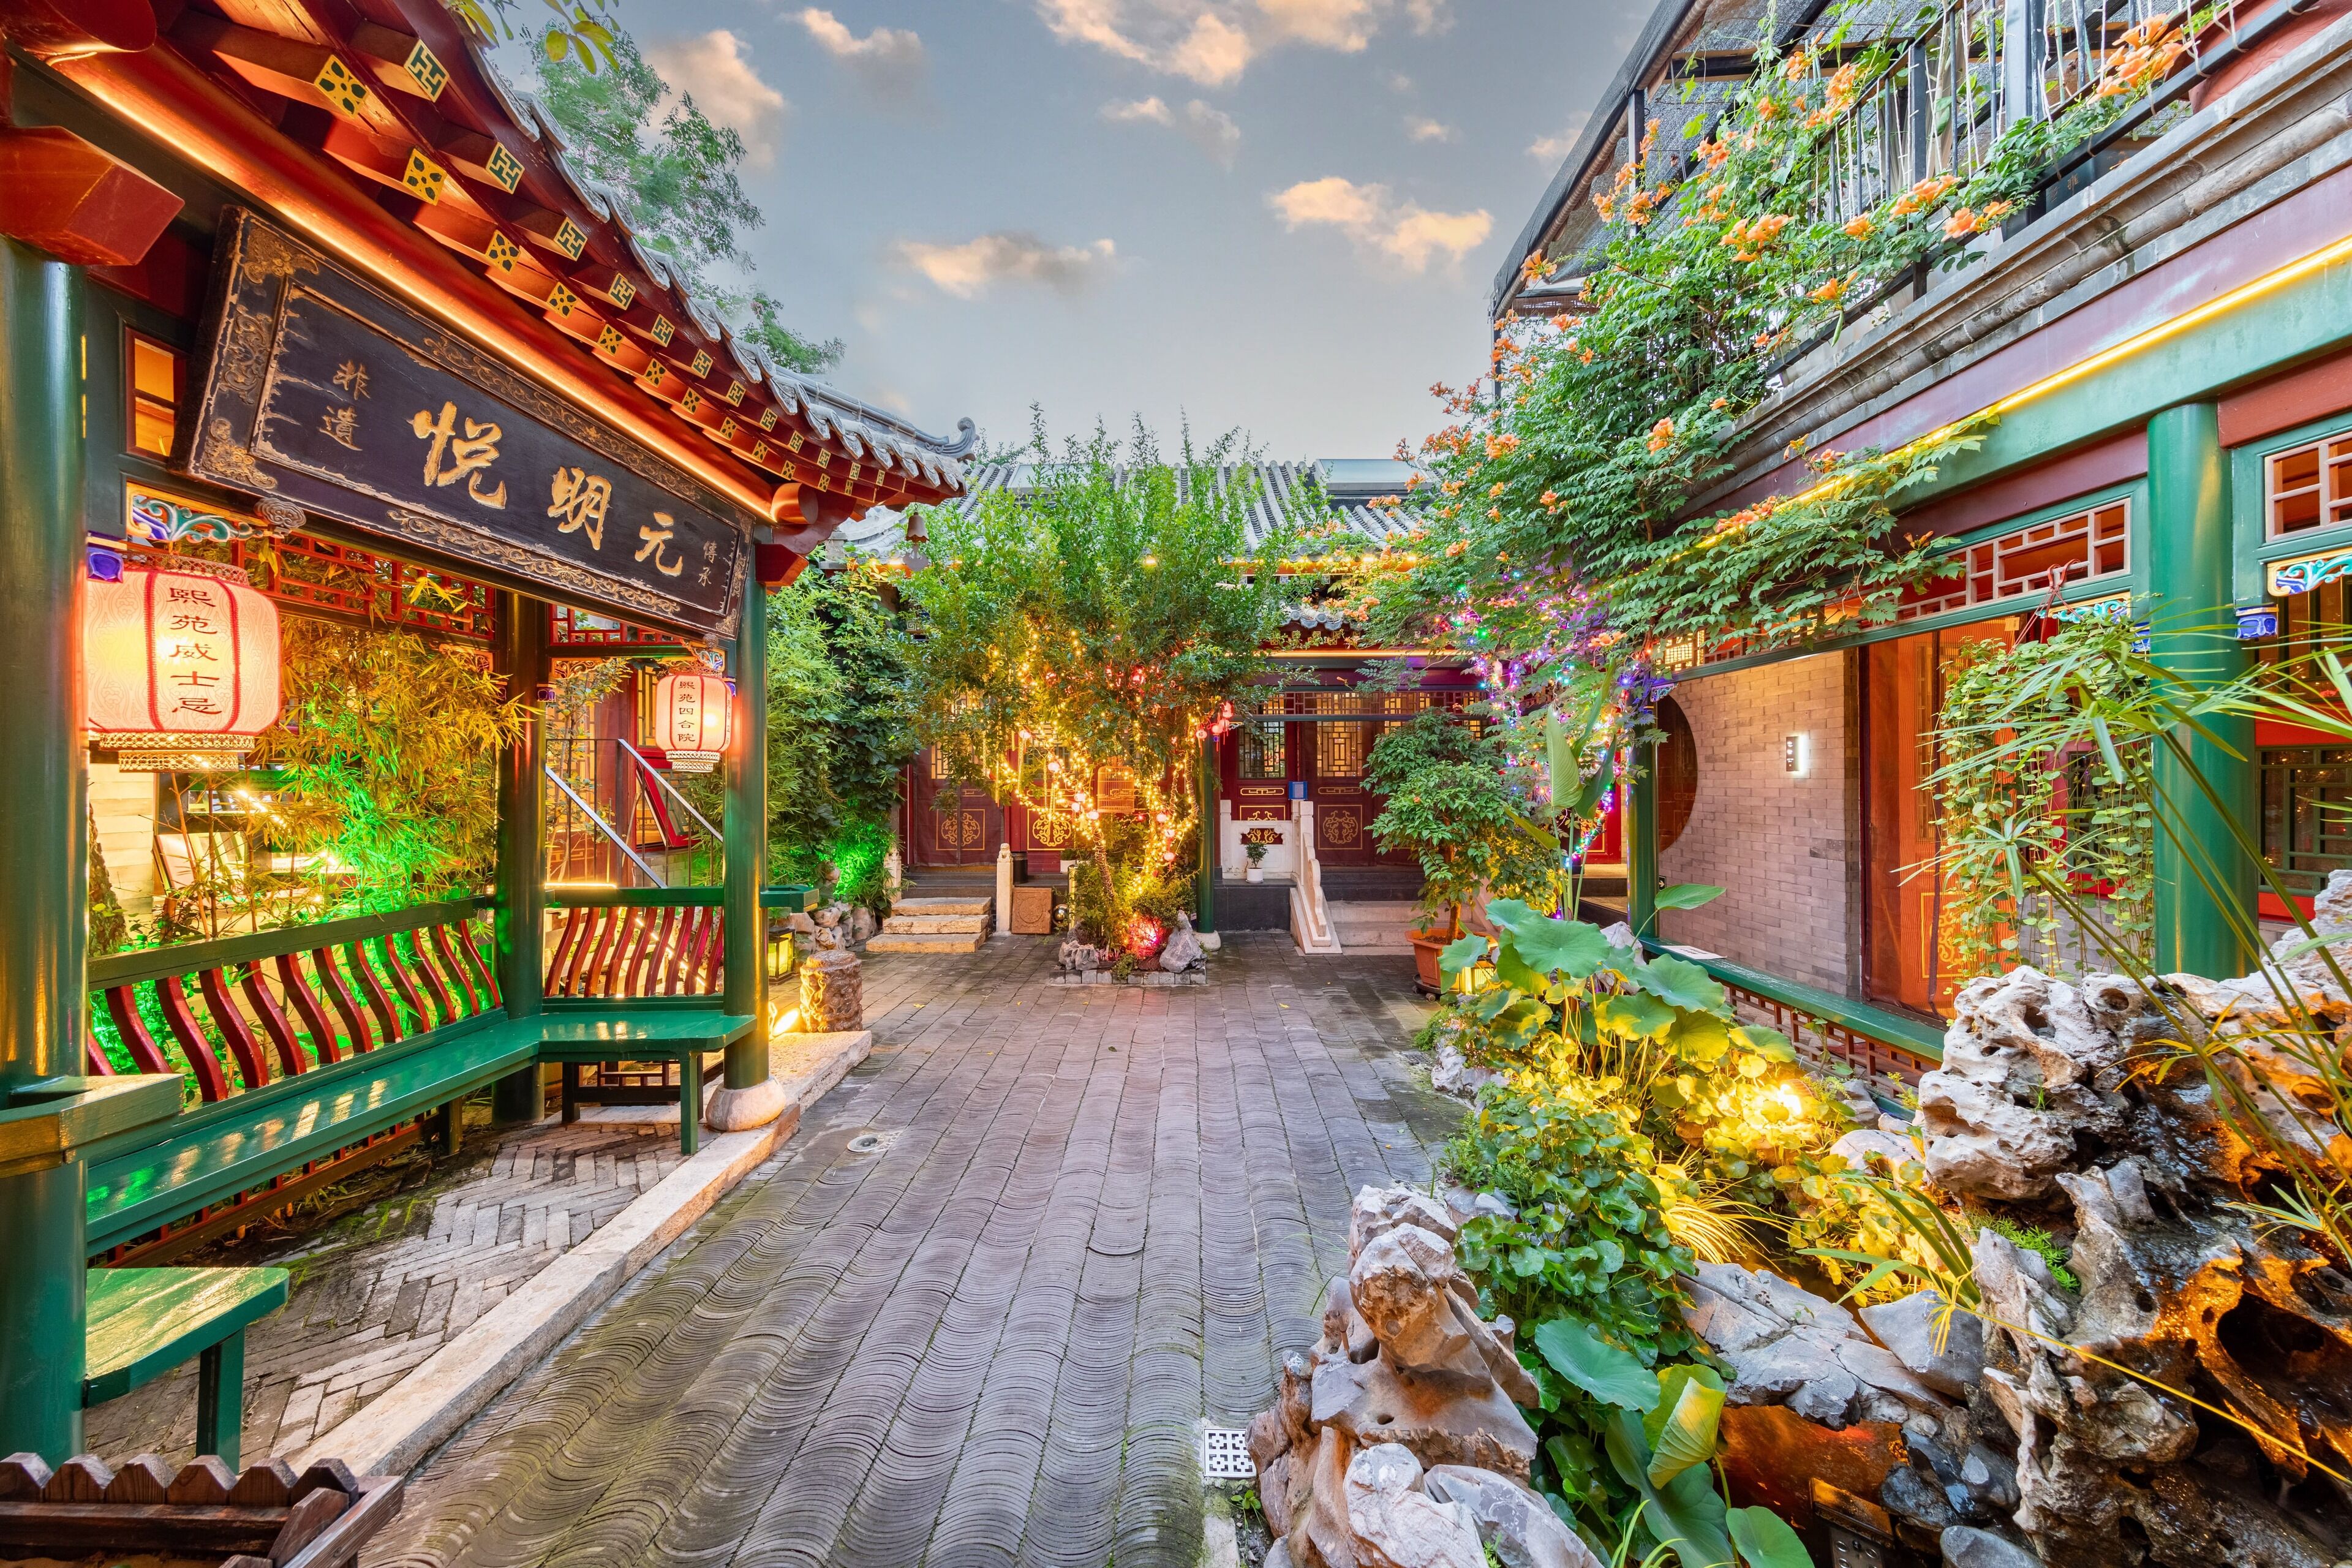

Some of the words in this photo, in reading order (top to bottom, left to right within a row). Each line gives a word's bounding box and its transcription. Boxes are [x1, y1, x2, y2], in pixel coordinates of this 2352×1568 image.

[165, 587, 222, 715] 熙苑威士忌
[677, 681, 696, 742] 熙苑四合院
